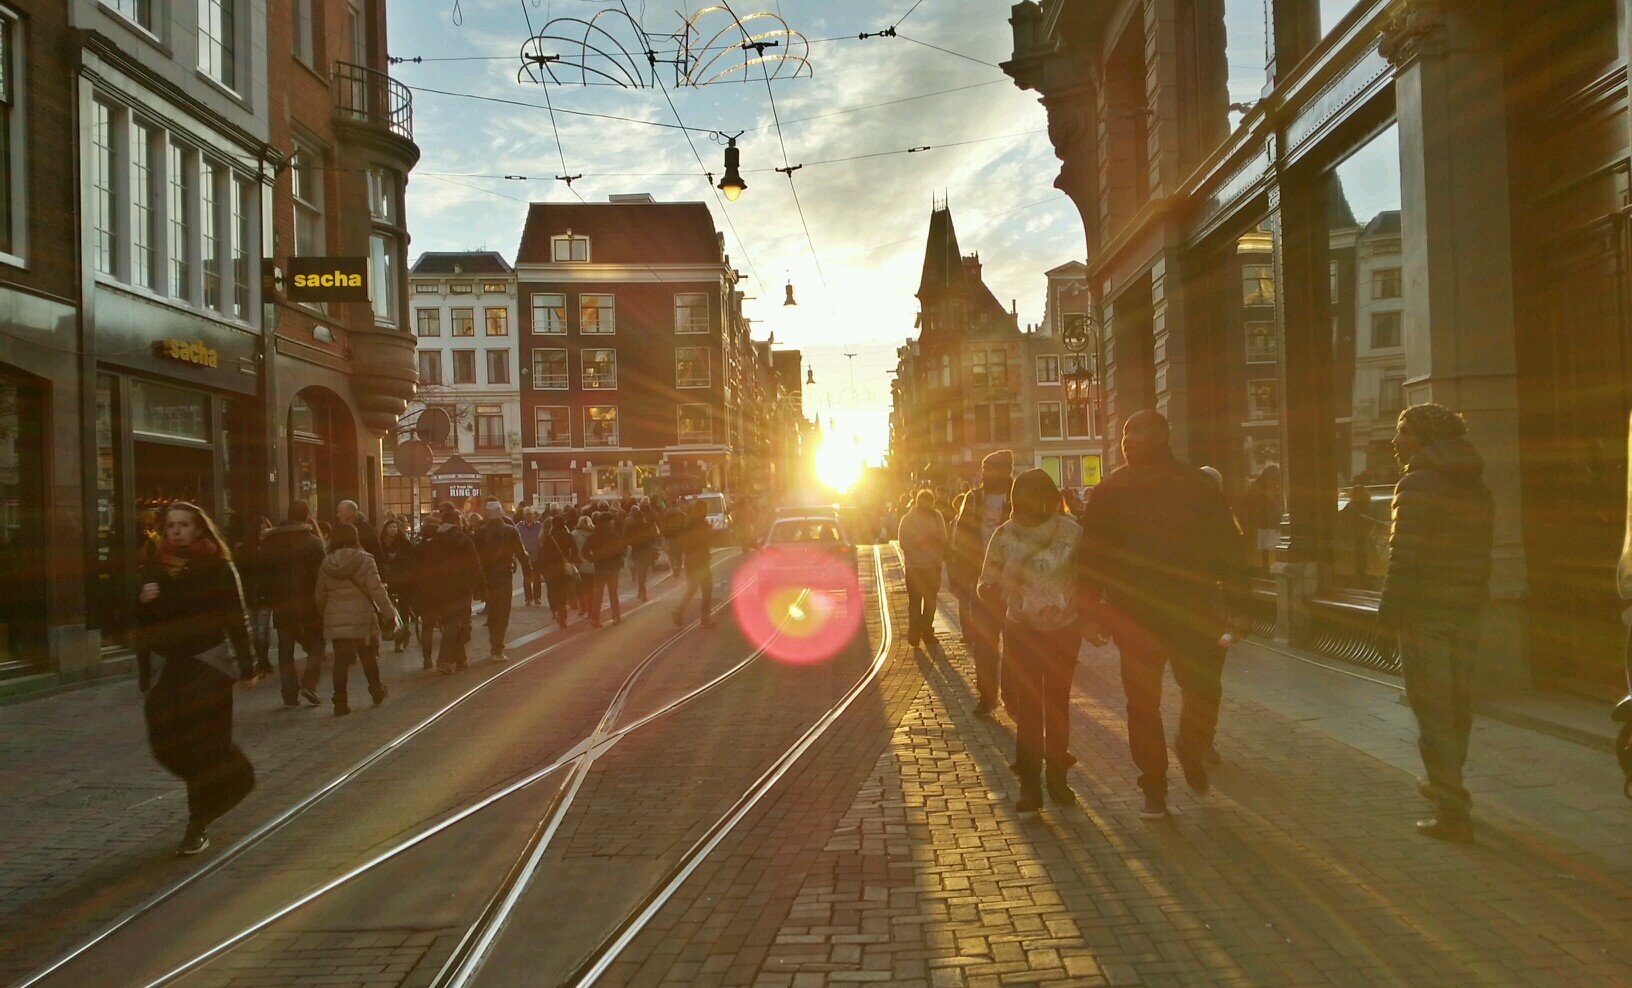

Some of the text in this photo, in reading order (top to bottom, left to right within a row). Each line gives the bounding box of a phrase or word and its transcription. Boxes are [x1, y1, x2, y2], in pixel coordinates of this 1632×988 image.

[294, 270, 362, 287] sacha
[169, 339, 218, 368] sacha
[450, 488, 470, 497] RING
